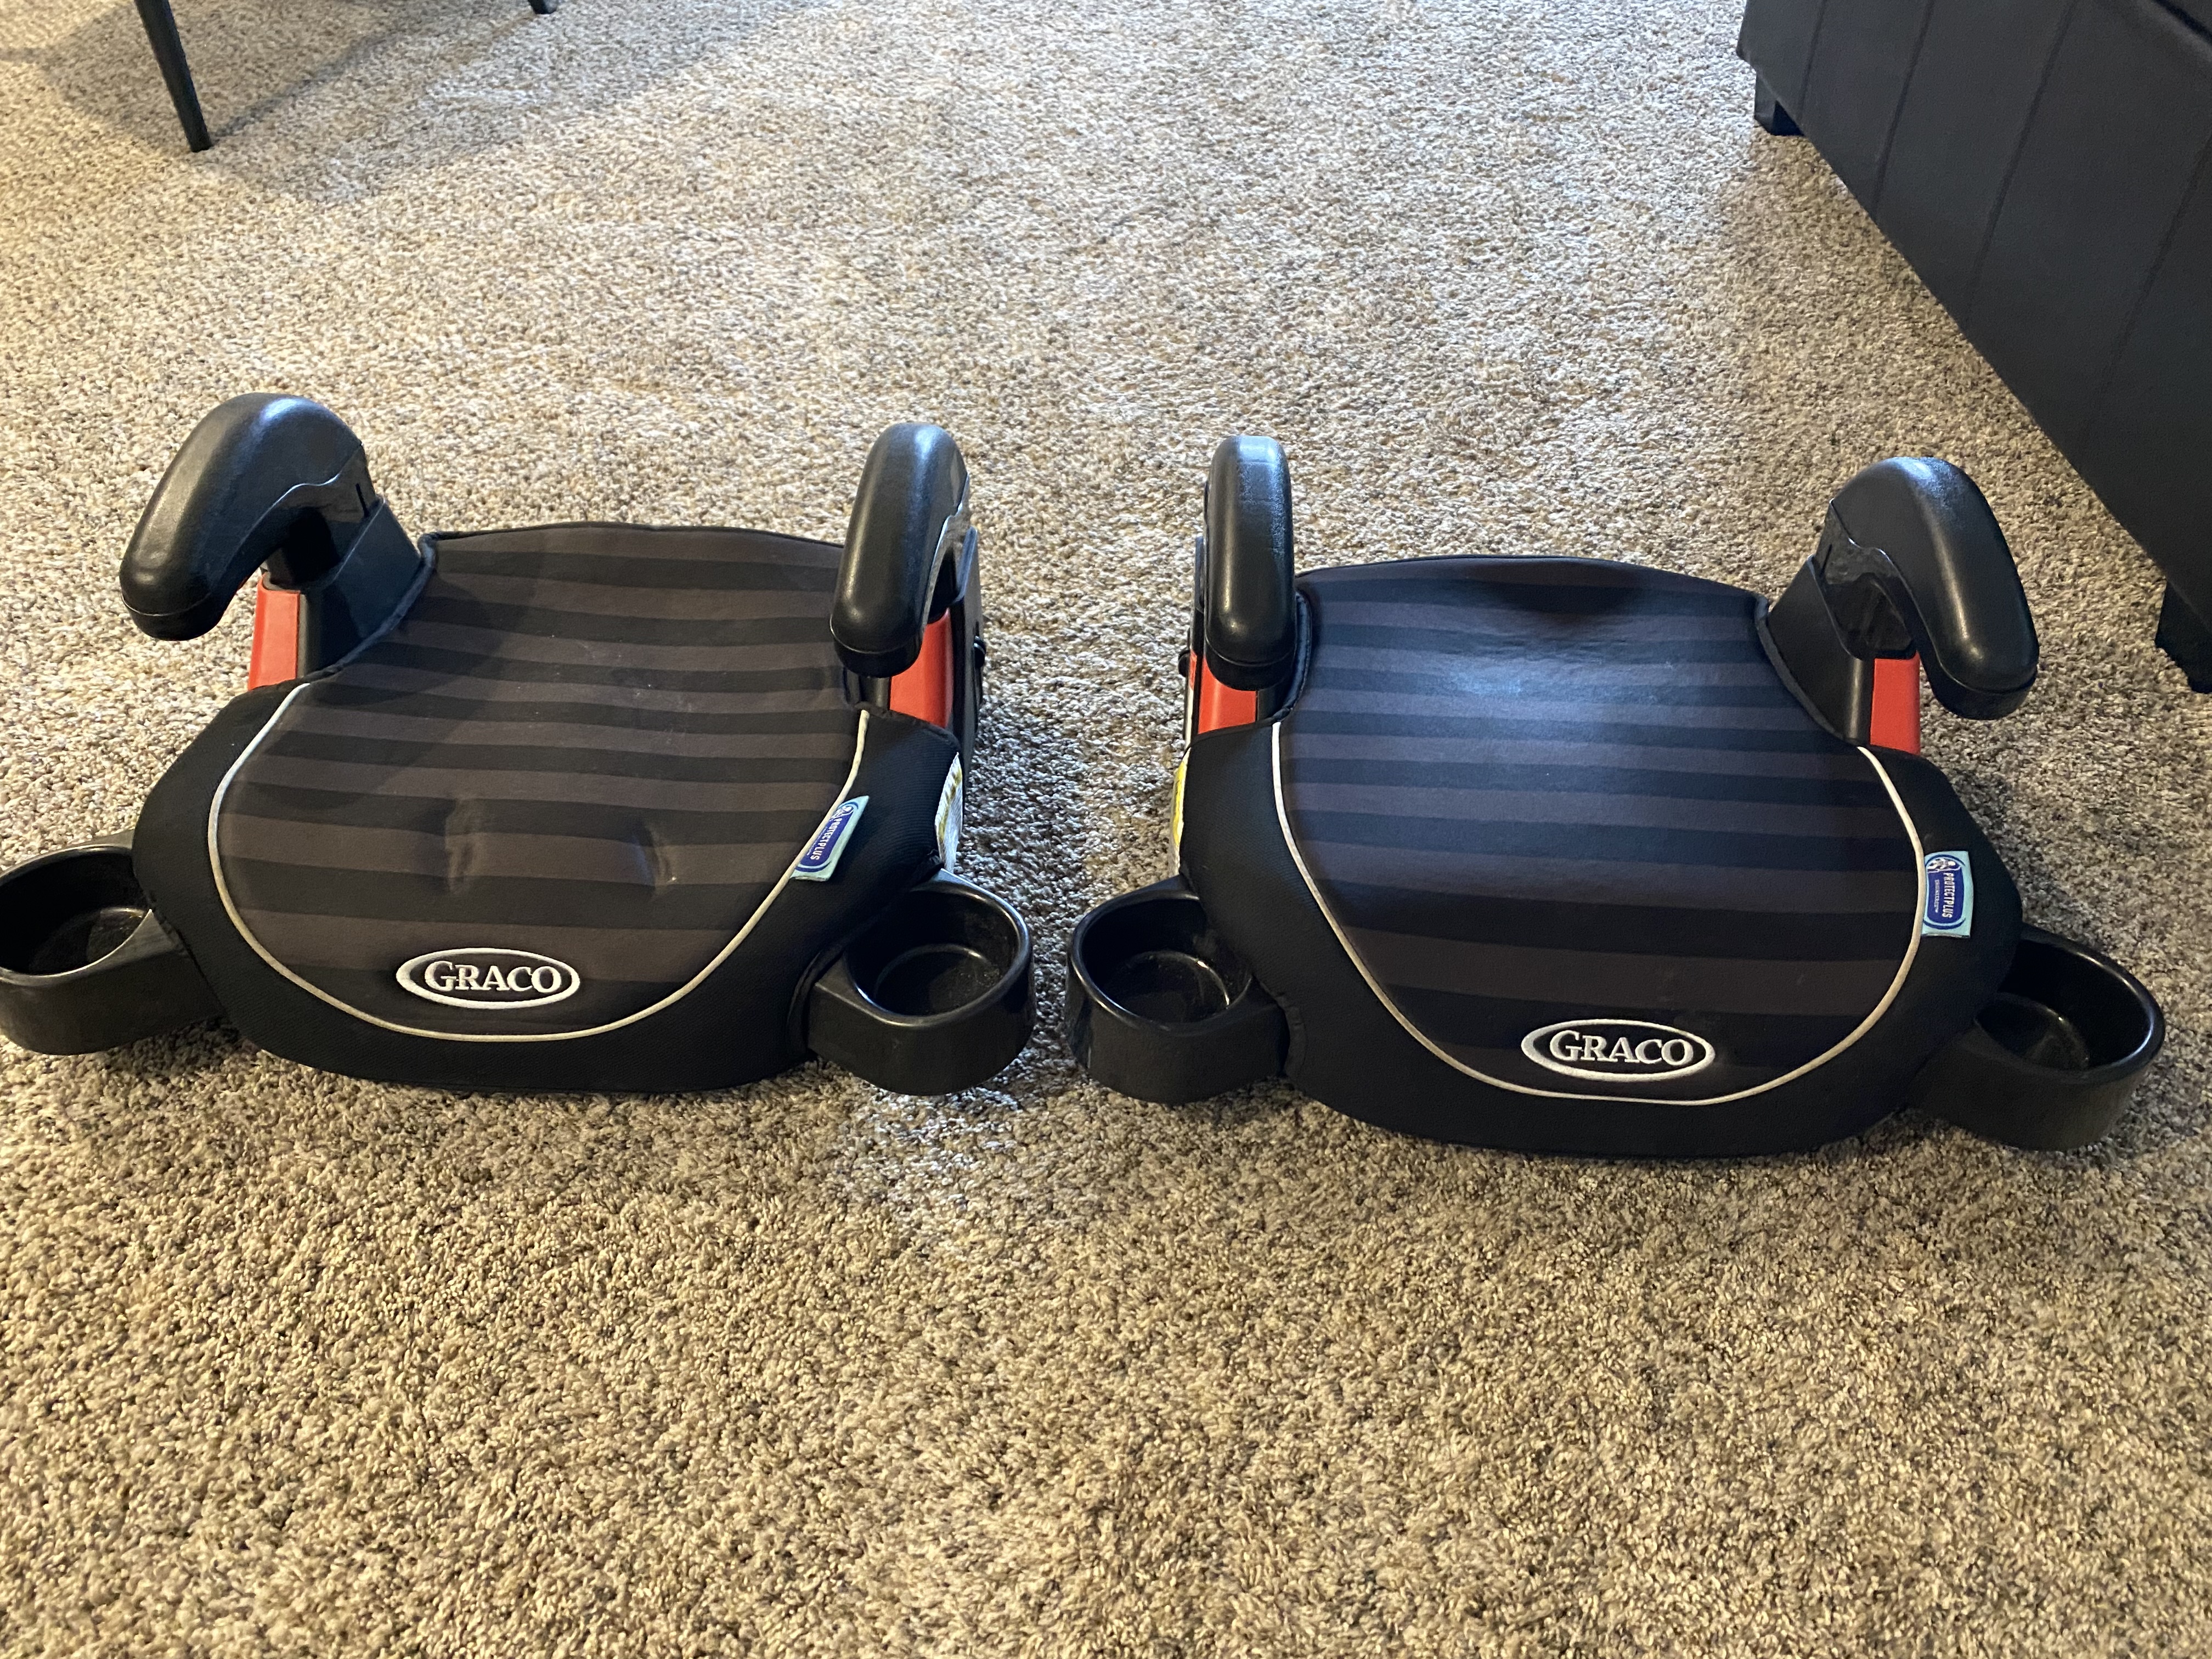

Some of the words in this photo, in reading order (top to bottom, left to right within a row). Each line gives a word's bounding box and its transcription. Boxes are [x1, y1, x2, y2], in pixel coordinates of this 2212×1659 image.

[810, 817, 842, 860] PROTECTPLUS
[1942, 872, 1955, 918] PROTECTPLUS
[425, 961, 561, 993] GRACO
[1550, 1030, 1694, 1065] GRACO
